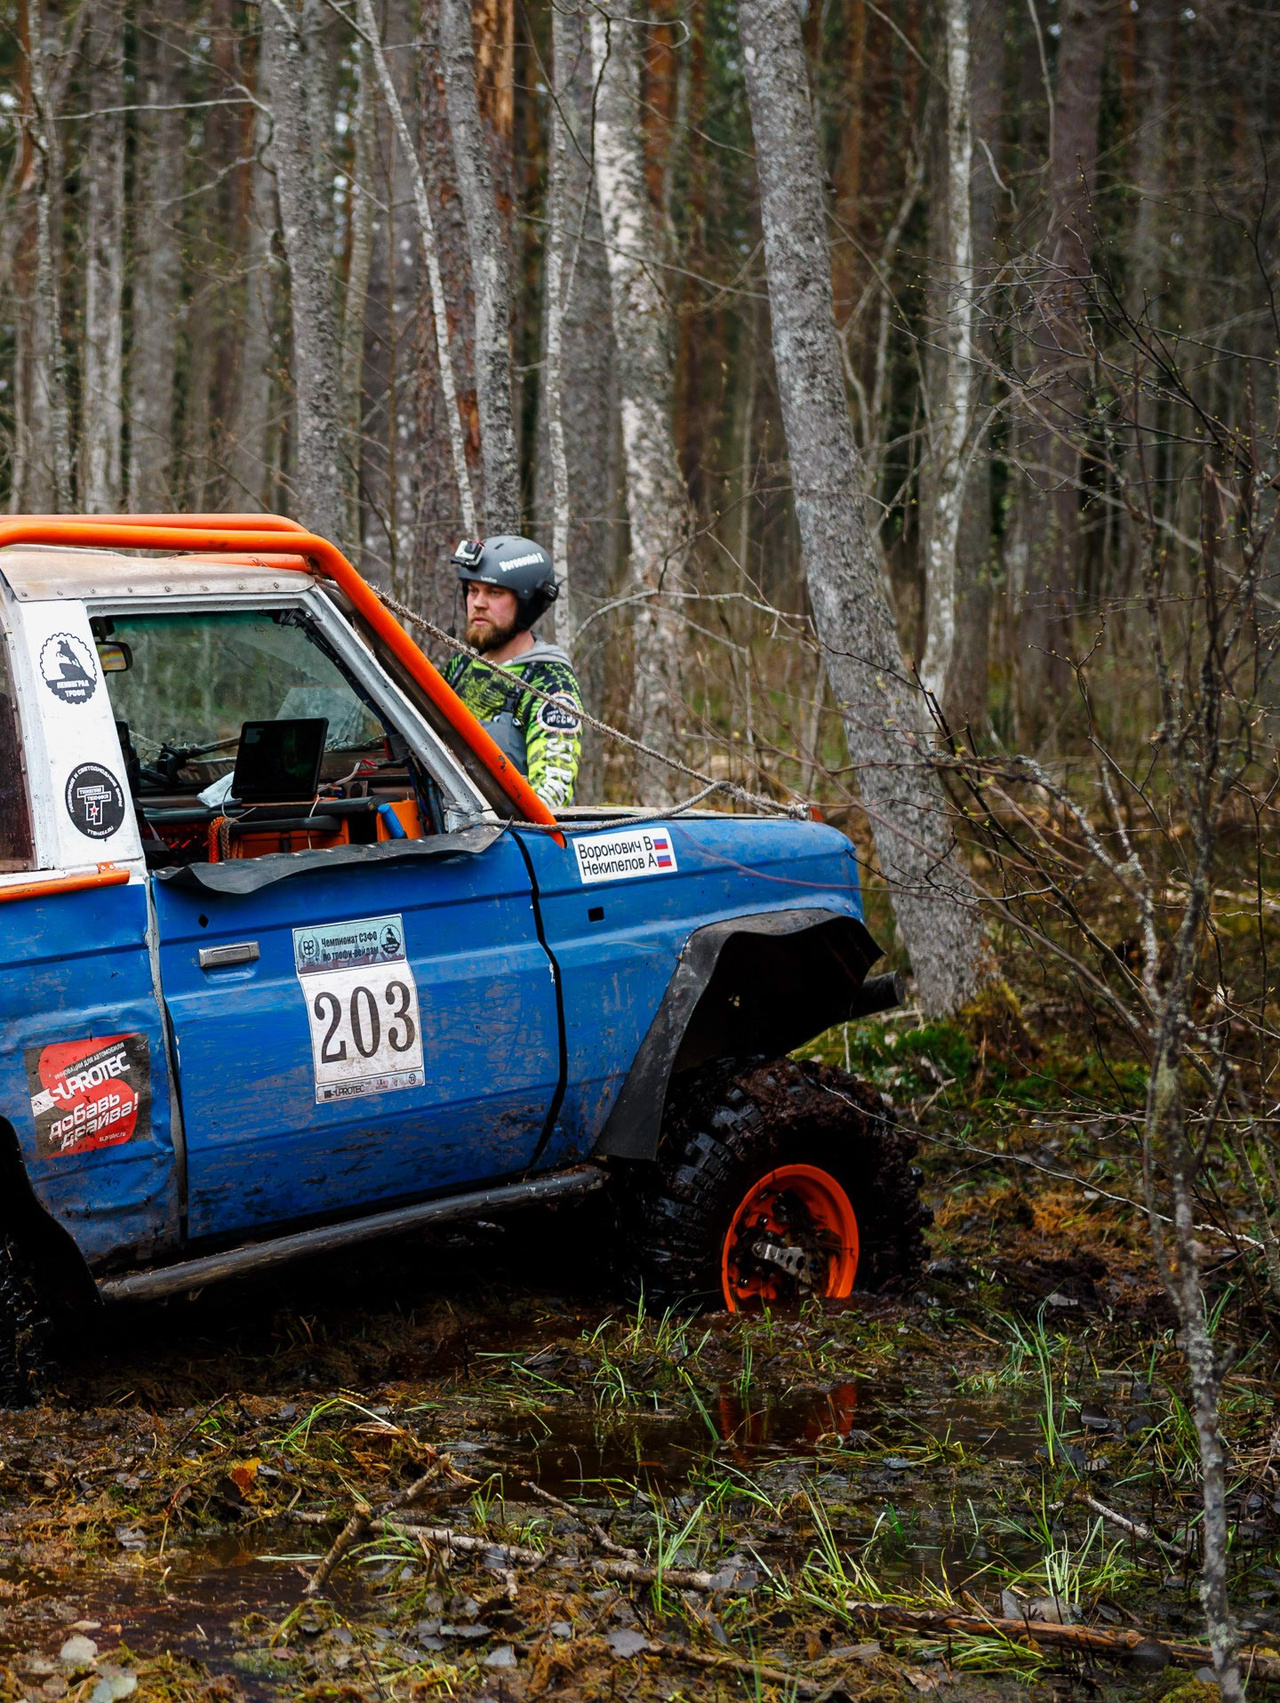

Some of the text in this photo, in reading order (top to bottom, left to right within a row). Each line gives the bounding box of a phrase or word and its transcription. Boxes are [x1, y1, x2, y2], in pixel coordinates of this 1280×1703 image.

[578, 836, 653, 861] Воронович В
[581, 852, 658, 876] Некипелов А
[321, 931, 378, 948] Чемпионат СЗФО
[313, 980, 416, 1064] 203
